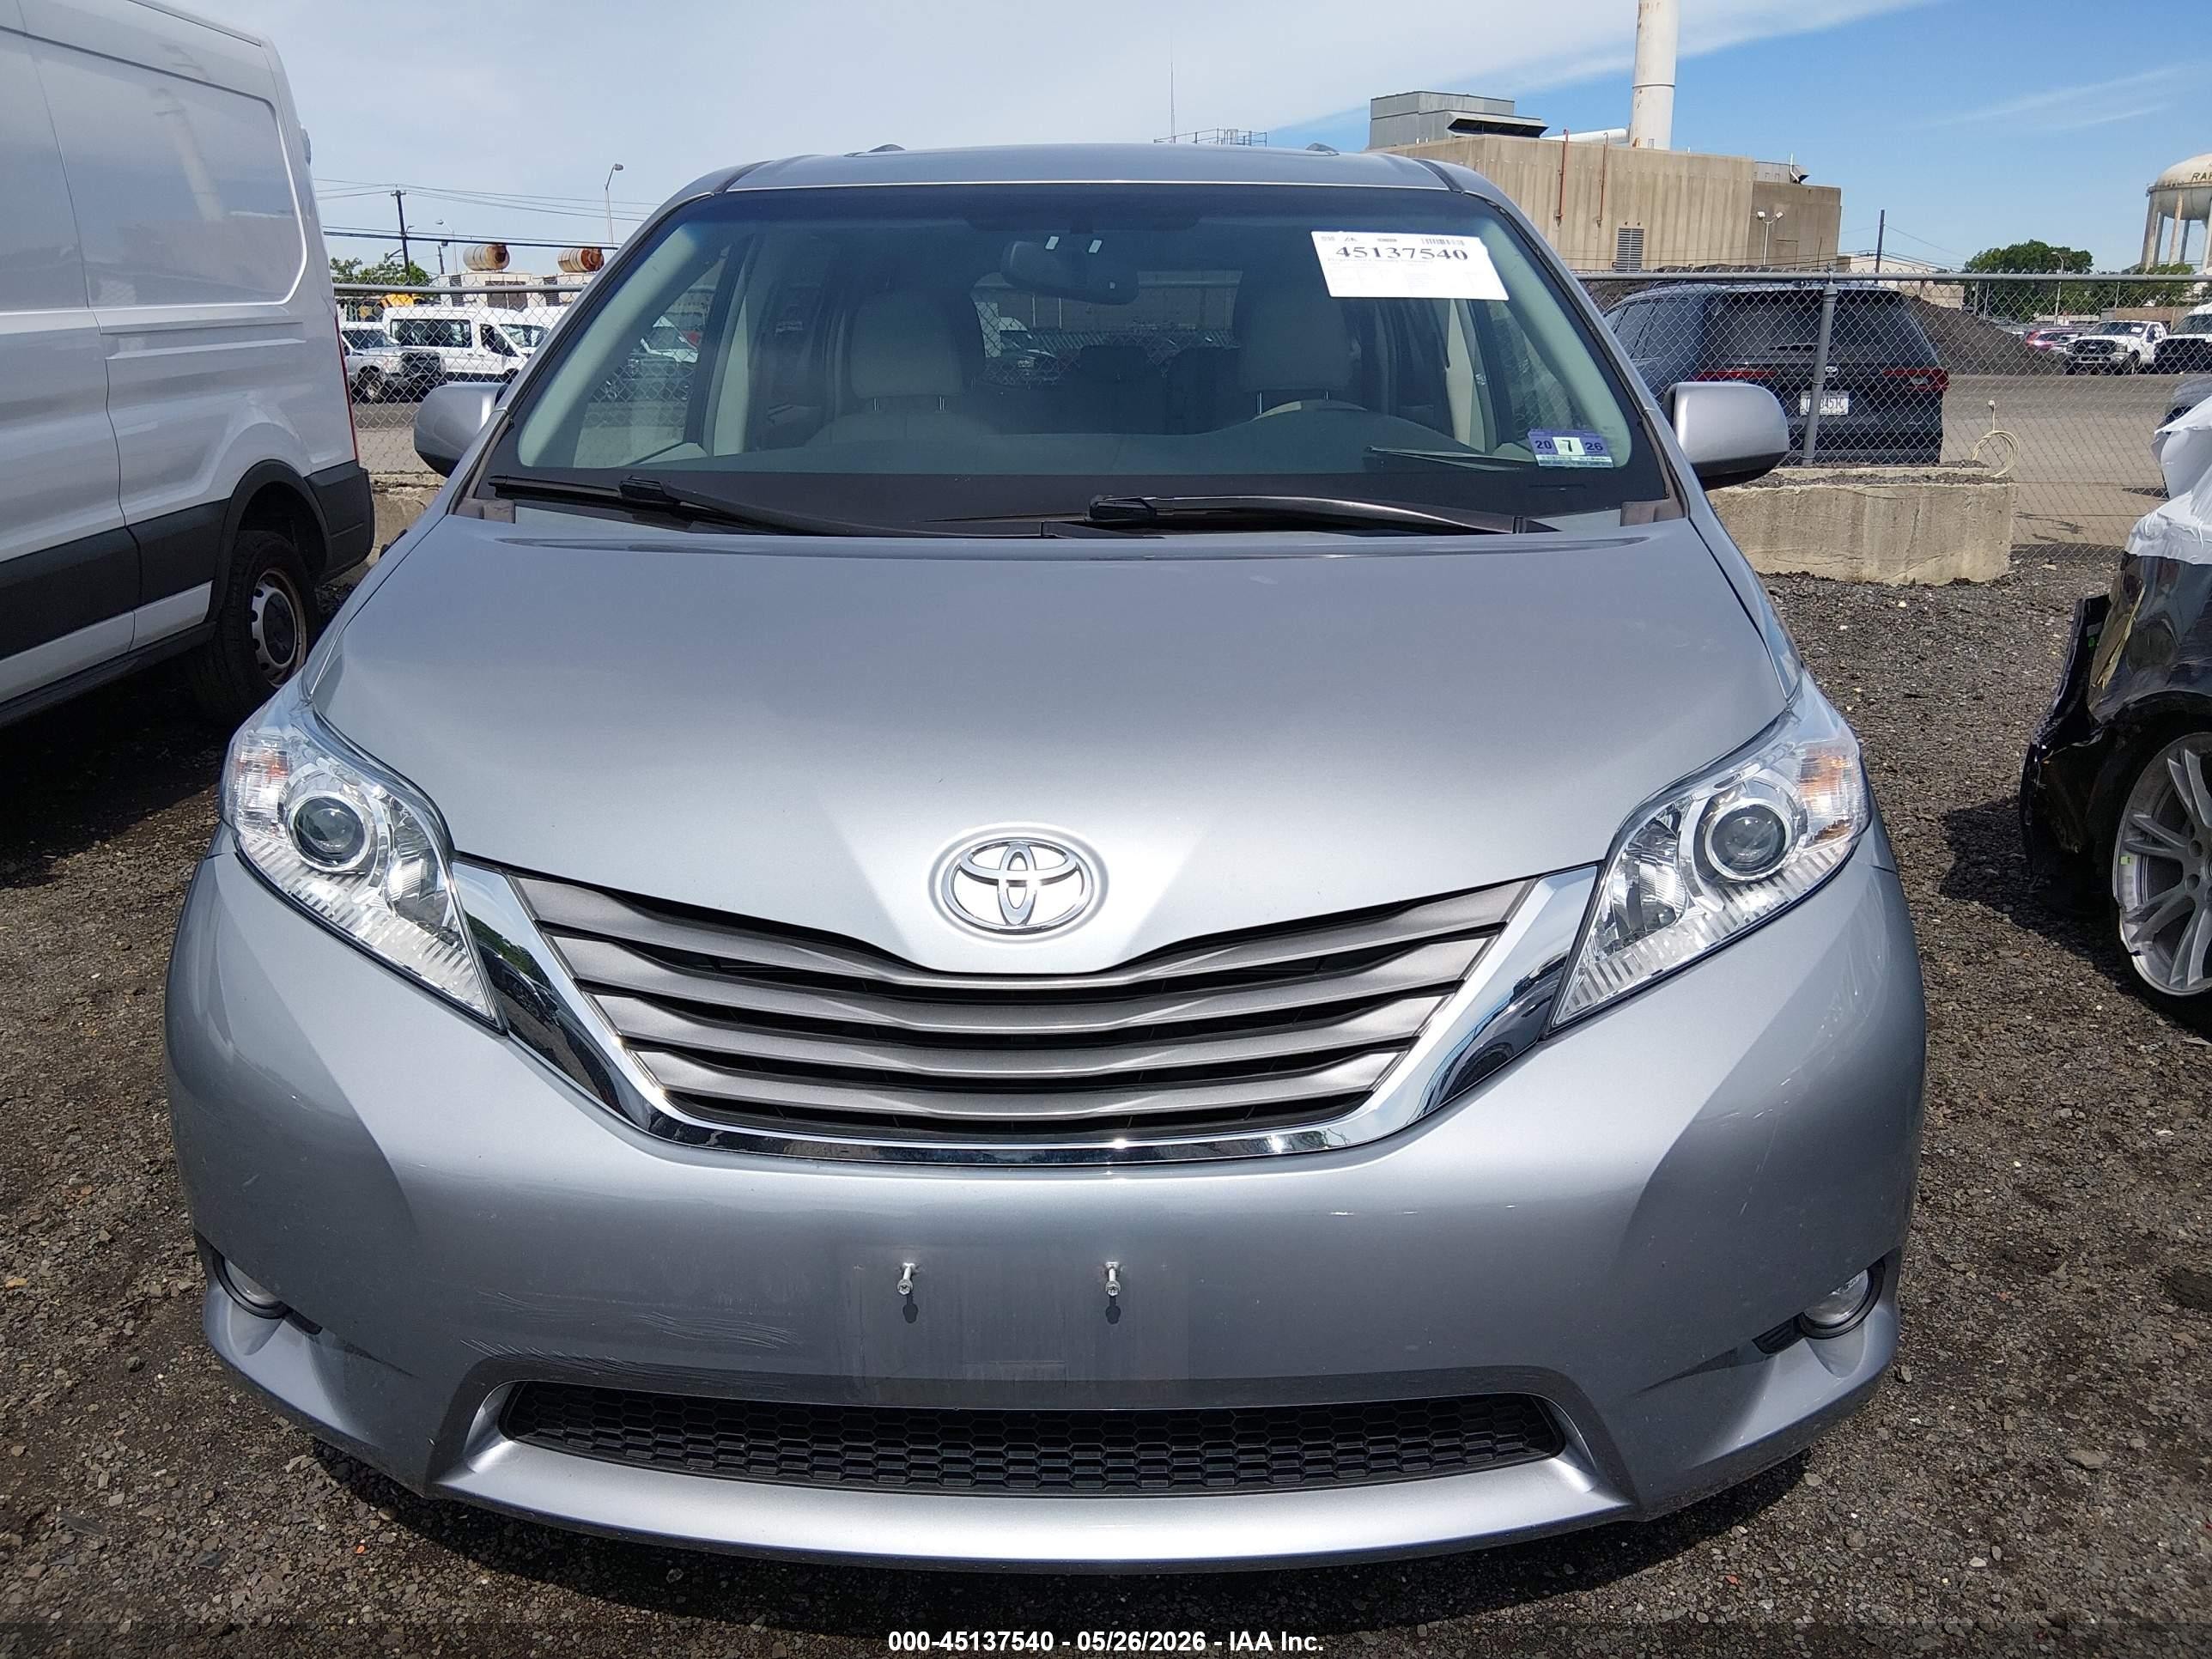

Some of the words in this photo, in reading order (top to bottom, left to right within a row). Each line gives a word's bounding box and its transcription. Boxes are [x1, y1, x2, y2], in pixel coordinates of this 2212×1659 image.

[1335, 246, 1468, 261] 45137540
[1534, 440, 1552, 449] 20
[1561, 439, 1573, 453] 7
[1584, 442, 1603, 451] 26
